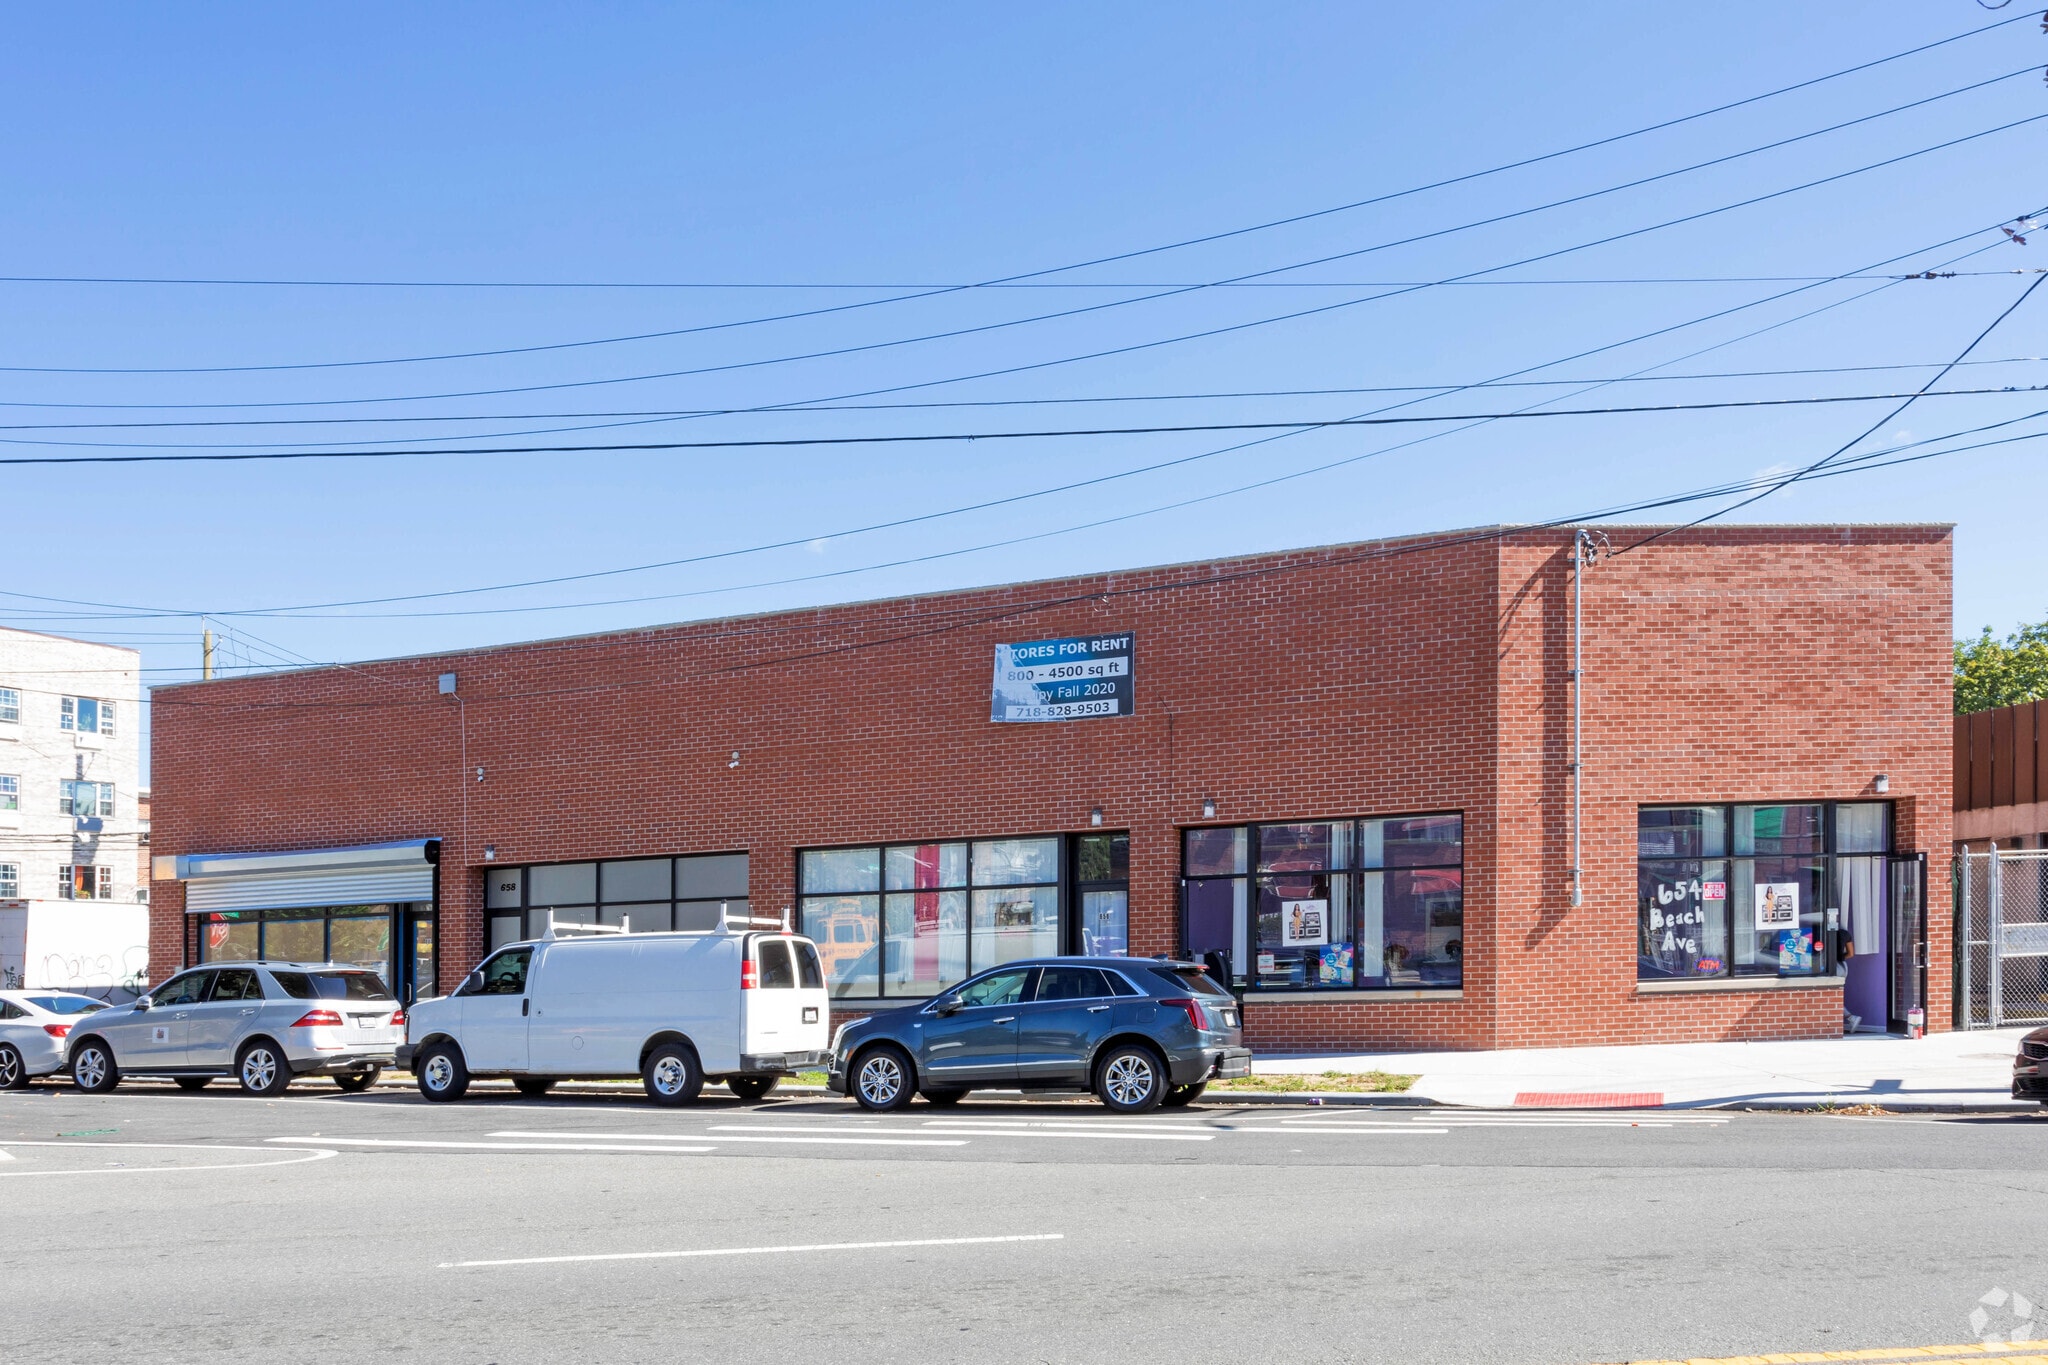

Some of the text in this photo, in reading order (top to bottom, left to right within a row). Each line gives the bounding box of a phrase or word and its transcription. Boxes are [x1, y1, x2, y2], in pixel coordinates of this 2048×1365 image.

[1011, 637, 1130, 660] TORES FOR RENT
[1007, 670, 1034, 681] 800
[1048, 665, 1083, 679] 4500
[1088, 664, 1104, 676] sq
[1108, 661, 1120, 673] ft
[1058, 685, 1080, 698] Fall
[1084, 682, 1116, 696] 2020
[1016, 702, 1110, 717] 718-828-9503
[500, 883, 516, 891] 658
[1658, 880, 1702, 905] 654
[1704, 888, 1725, 898] OPEN
[1650, 906, 1705, 930] Beach
[1661, 931, 1697, 954] Ave
[1698, 960, 1720, 970] ATM
